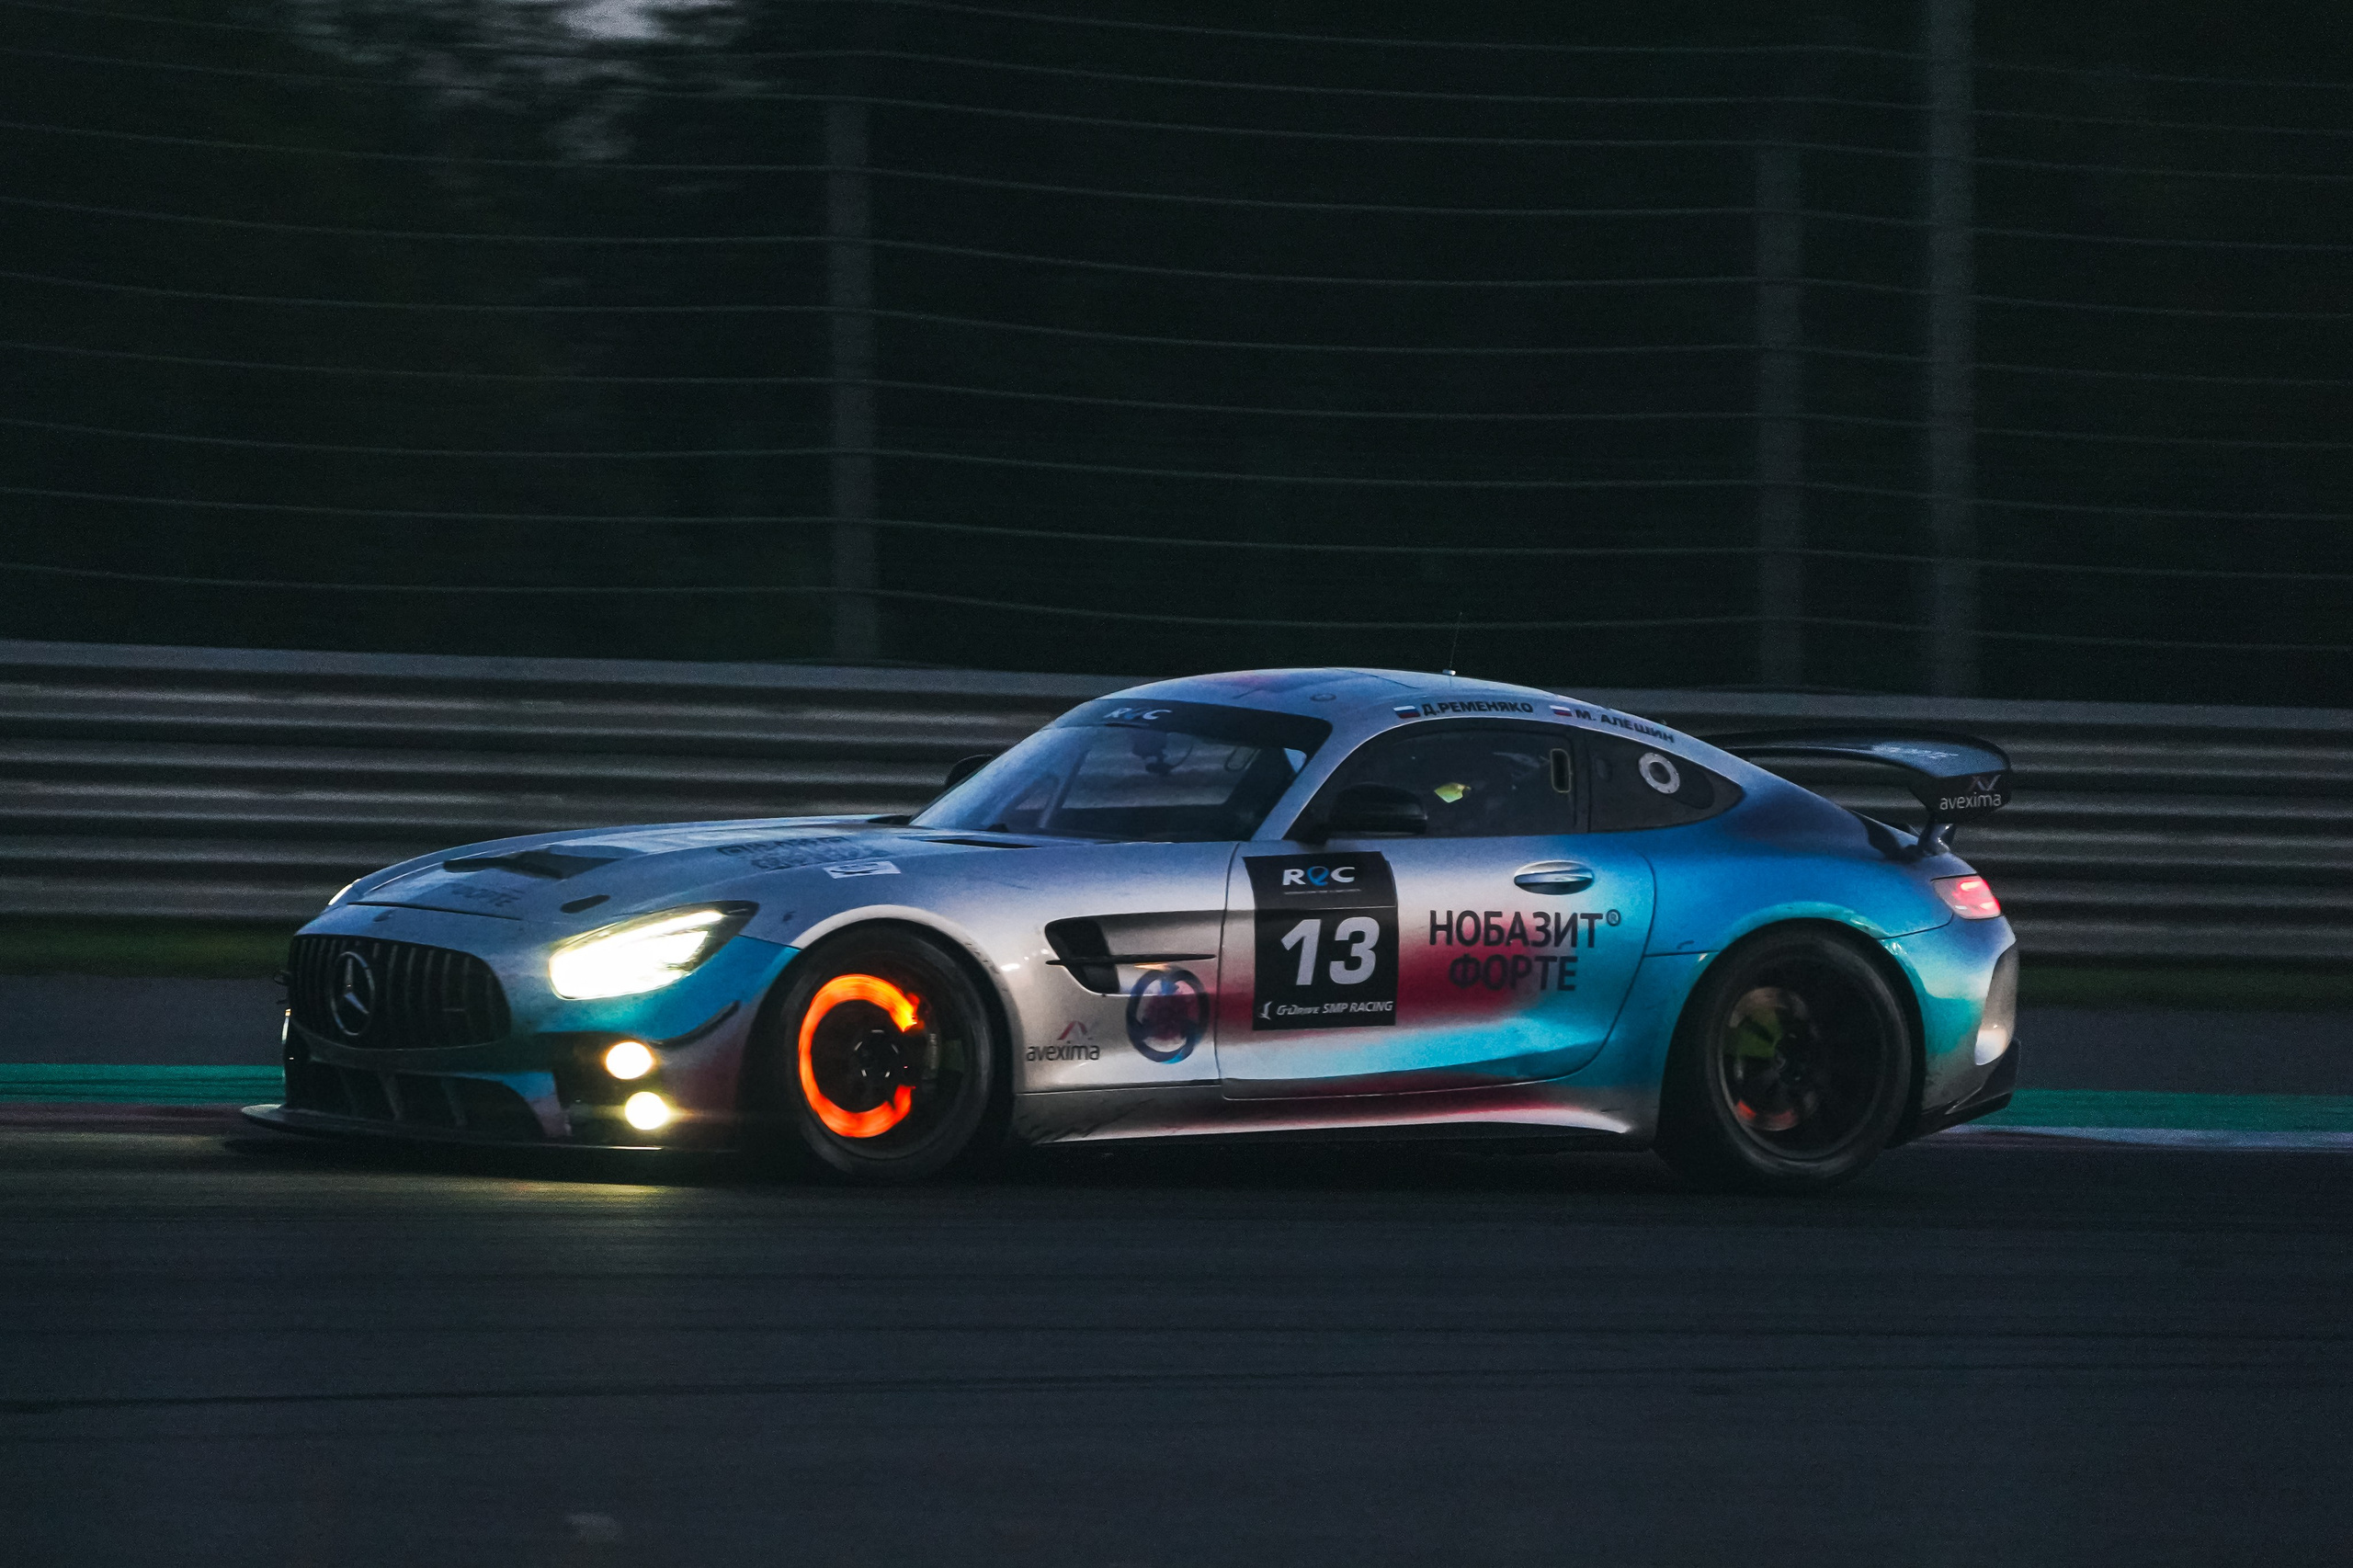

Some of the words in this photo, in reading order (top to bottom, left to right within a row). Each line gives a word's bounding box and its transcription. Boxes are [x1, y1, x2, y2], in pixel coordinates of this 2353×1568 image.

[1939, 792, 2002, 811] avexima
[1280, 916, 1381, 986] 13
[1449, 954, 1578, 992] ФОРТЕ
[1322, 1002, 1348, 1014] SMP
[1349, 1000, 1394, 1013] RACING
[1026, 1040, 1101, 1062] avexima
